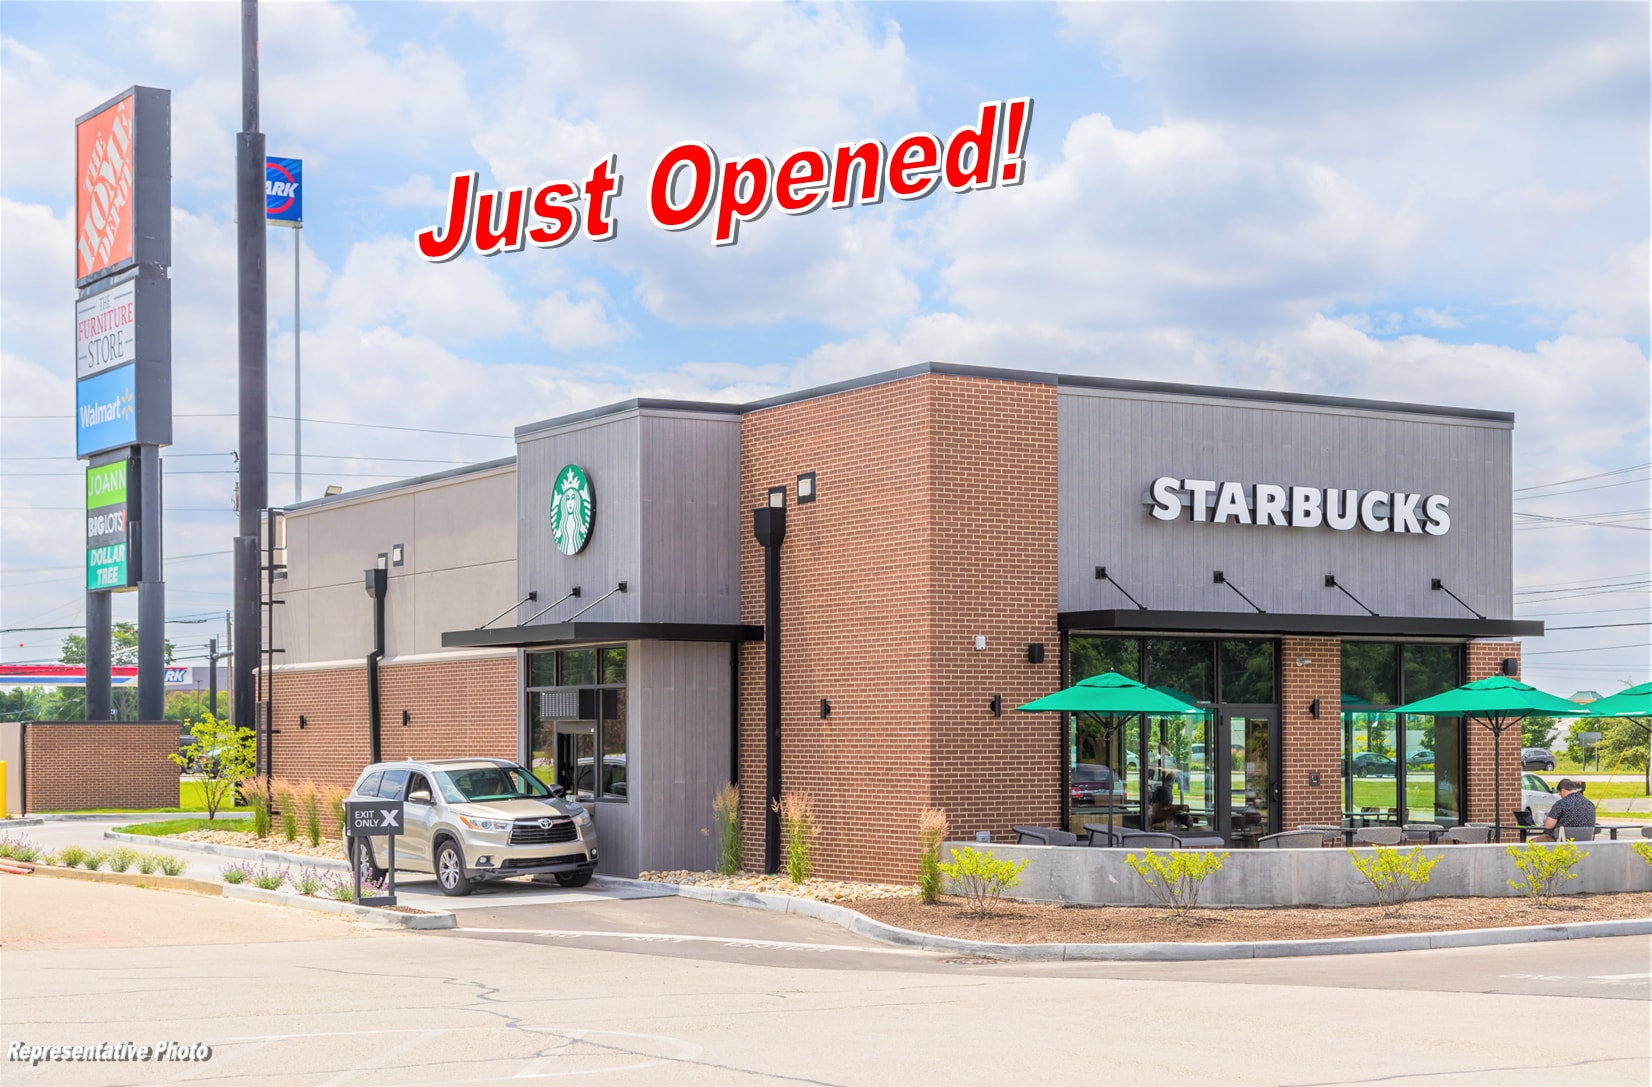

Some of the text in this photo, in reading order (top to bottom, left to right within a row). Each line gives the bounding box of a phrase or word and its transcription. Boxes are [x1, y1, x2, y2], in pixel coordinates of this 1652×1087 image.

[83, 131, 106, 194] THE
[78, 101, 131, 274] HOME
[98, 294, 111, 312] THE
[78, 302, 133, 341] FURNITURE
[88, 330, 124, 369] STORE
[80, 395, 120, 428] Walmart
[88, 468, 126, 497] JOANN
[1150, 476, 1450, 536] STARBUCKS
[90, 545, 125, 567] DOLLAR
[96, 566, 118, 586] TREE
[354, 810, 375, 819] EXIT
[354, 819, 379, 828] ONLY
